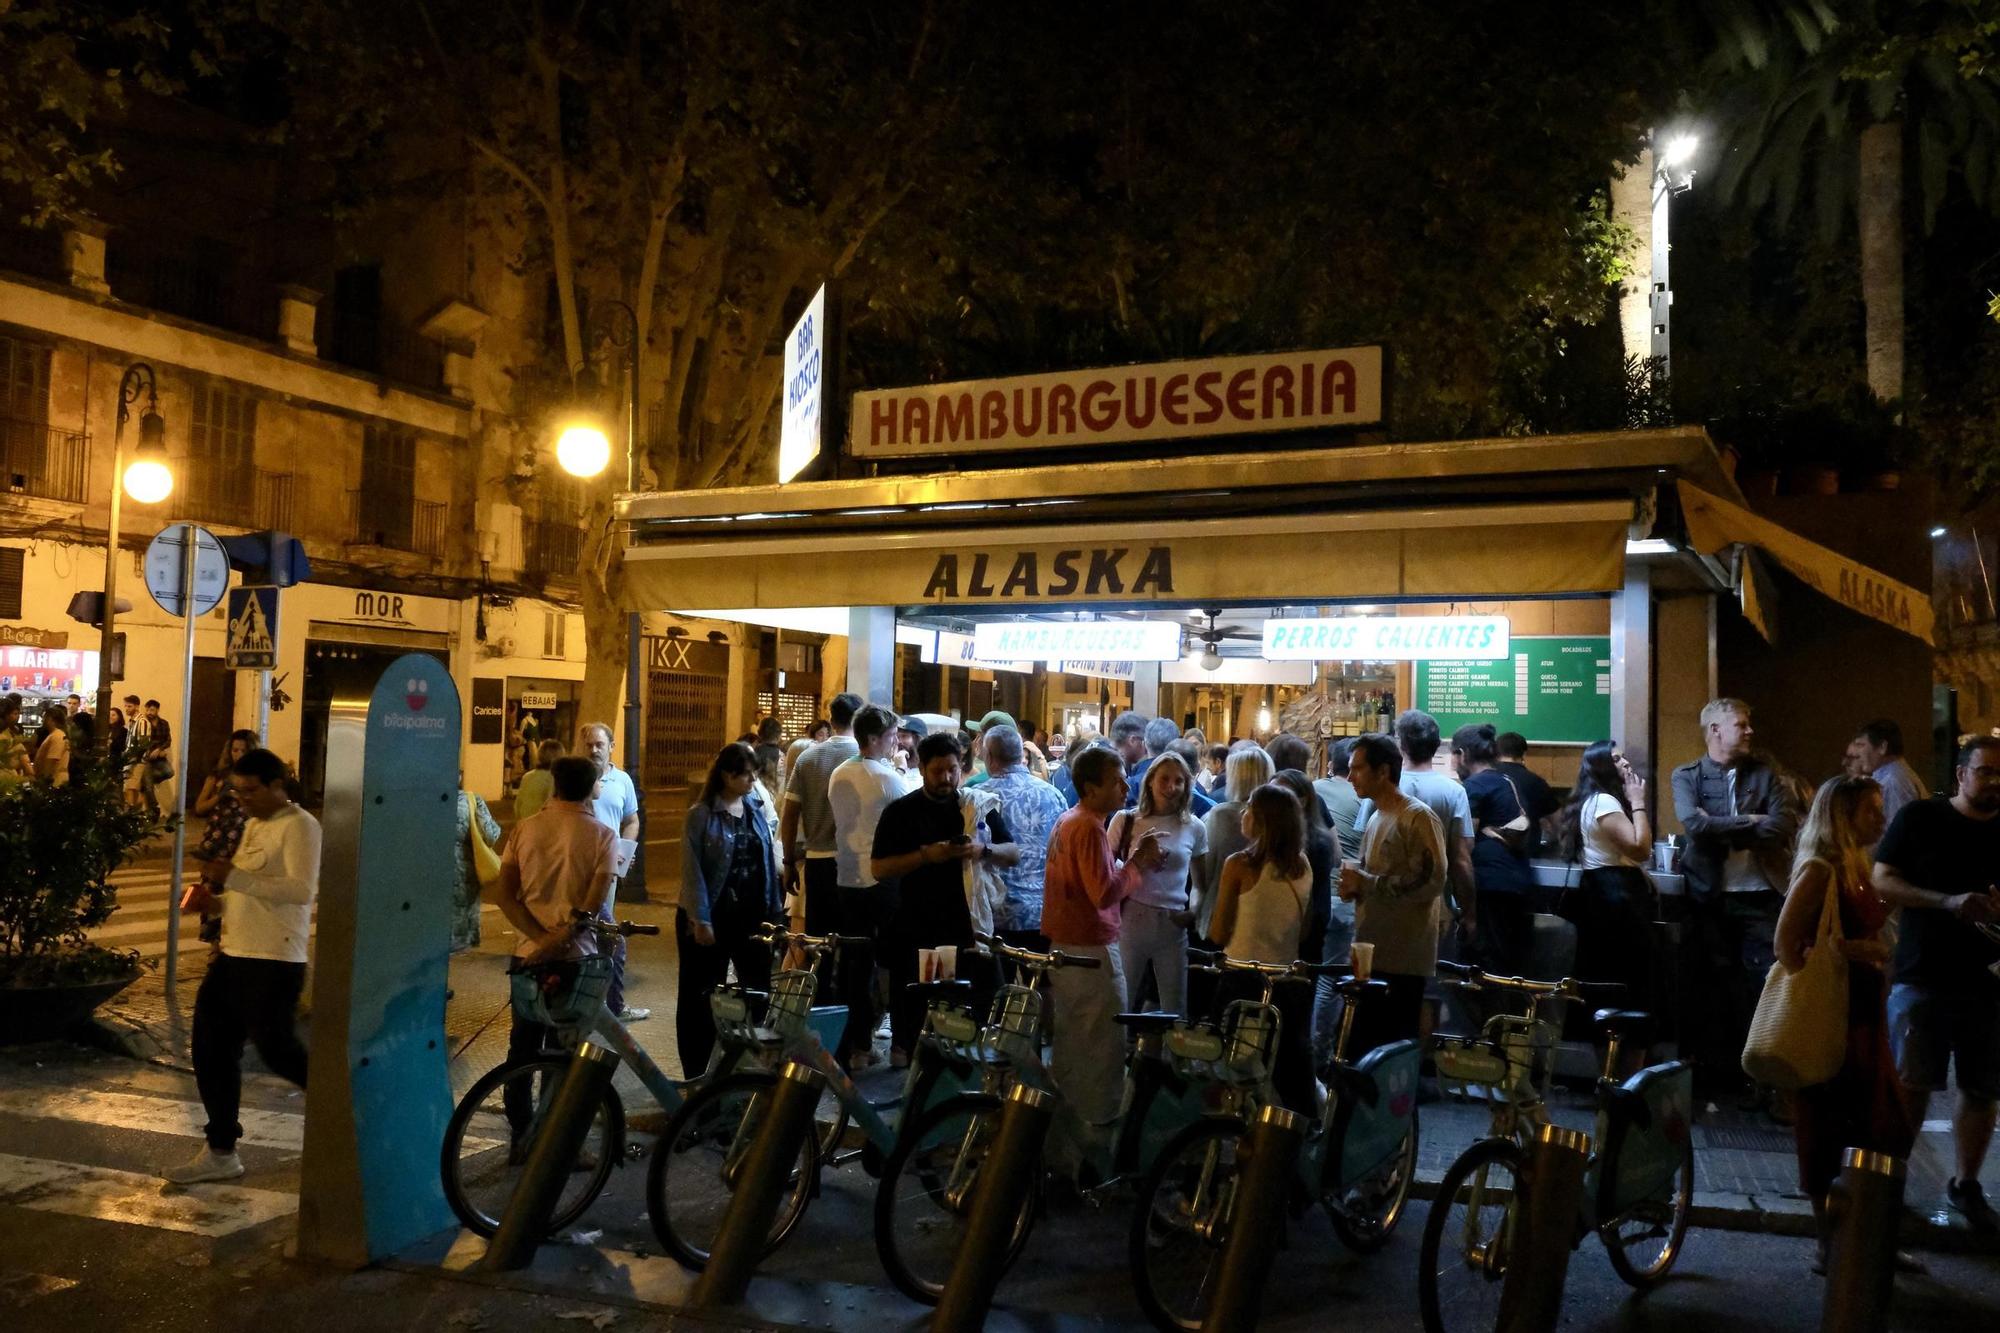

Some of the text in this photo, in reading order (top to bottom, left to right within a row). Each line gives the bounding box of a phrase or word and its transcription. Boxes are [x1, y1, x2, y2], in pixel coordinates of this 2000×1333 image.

[798, 314, 814, 363] BAR
[789, 348, 820, 413] KIOSCO
[870, 359, 1357, 447] HAMBURGUESERIA
[922, 547, 1175, 598] ALASKA
[355, 592, 403, 618] MOR
[1839, 567, 1912, 628] ALASKA
[8, 650, 79, 669] MARKET
[1272, 623, 1496, 649] PERROS CALIENTES
[522, 695, 555, 706] REBAJAS
